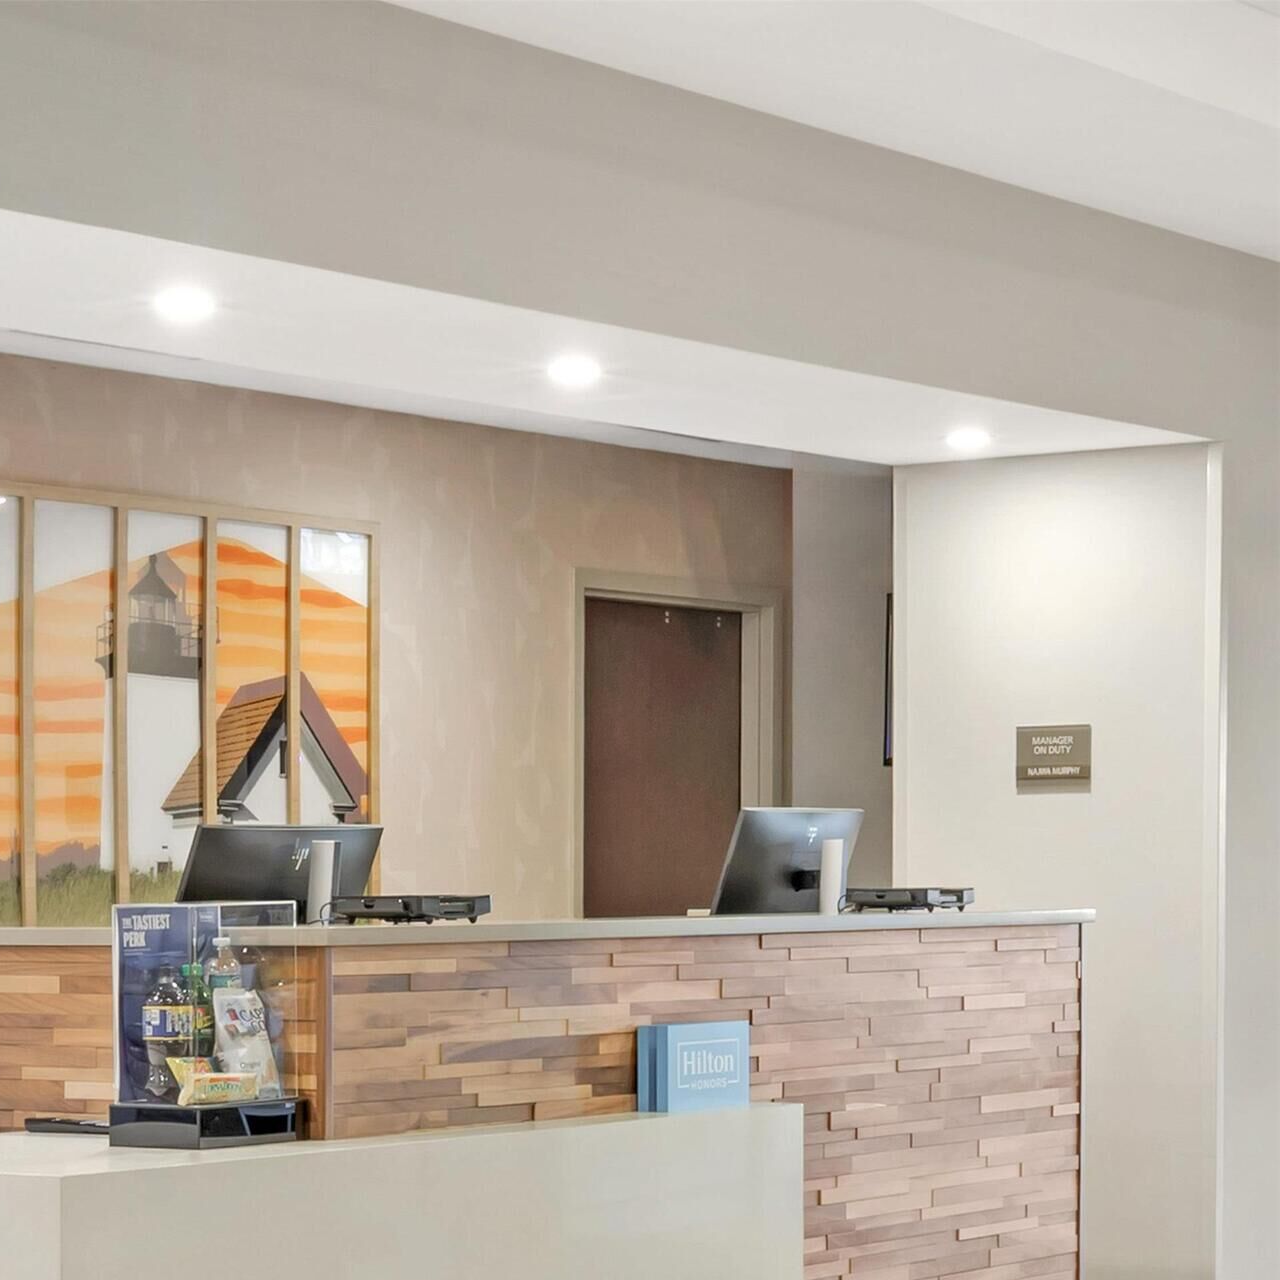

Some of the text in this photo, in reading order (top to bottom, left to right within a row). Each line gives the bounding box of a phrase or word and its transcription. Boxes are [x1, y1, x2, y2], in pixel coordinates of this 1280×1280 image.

[1032, 736, 1073, 746] MANAGER
[1033, 745, 1072, 755] ON DUTY
[132, 914, 170, 931] TASTIEST
[123, 931, 146, 948] PERK
[239, 1006, 265, 1022] CAP
[250, 1019, 266, 1034] CO
[683, 1050, 734, 1075] Hilton
